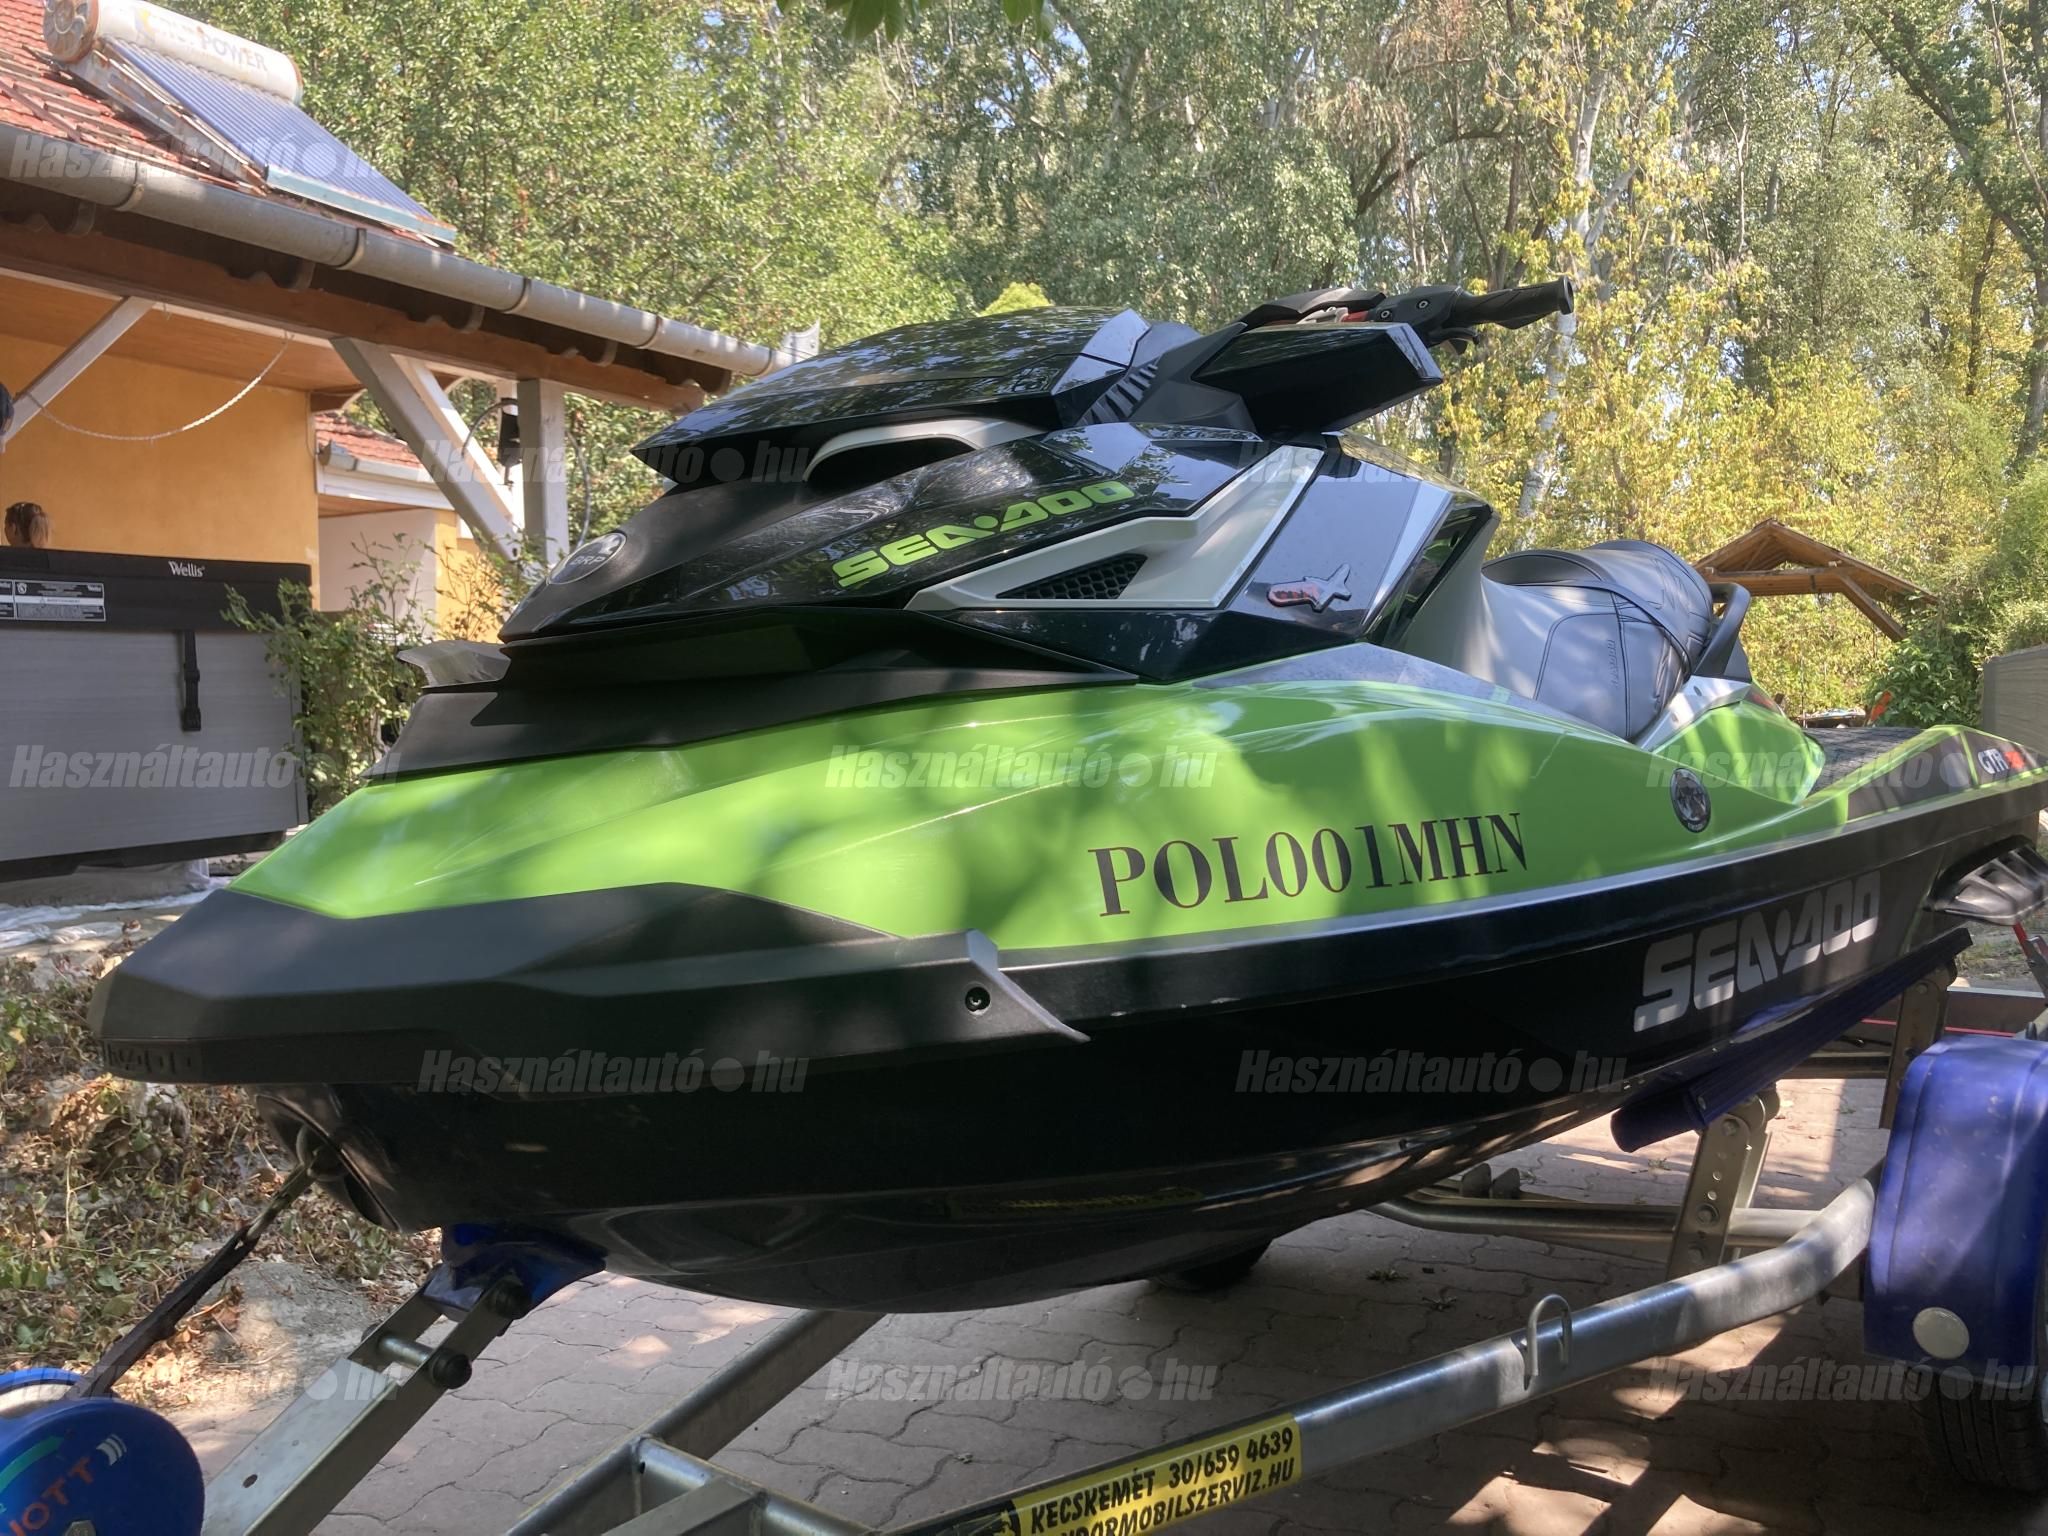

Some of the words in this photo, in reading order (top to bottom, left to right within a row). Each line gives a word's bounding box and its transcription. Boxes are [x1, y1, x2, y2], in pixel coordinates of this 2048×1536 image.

[168, 560, 204, 577] Wellis
[1978, 748, 2009, 774] GTR
[1088, 812, 1528, 917] POL001MHN
[1031, 1467, 1156, 1535] KECSKEMÉT
[1169, 1444, 1240, 1489] 30/659
[1246, 1427, 1294, 1463] 4639
[1060, 1457, 1295, 1536] ORMOBILSZERVIZ.HU
